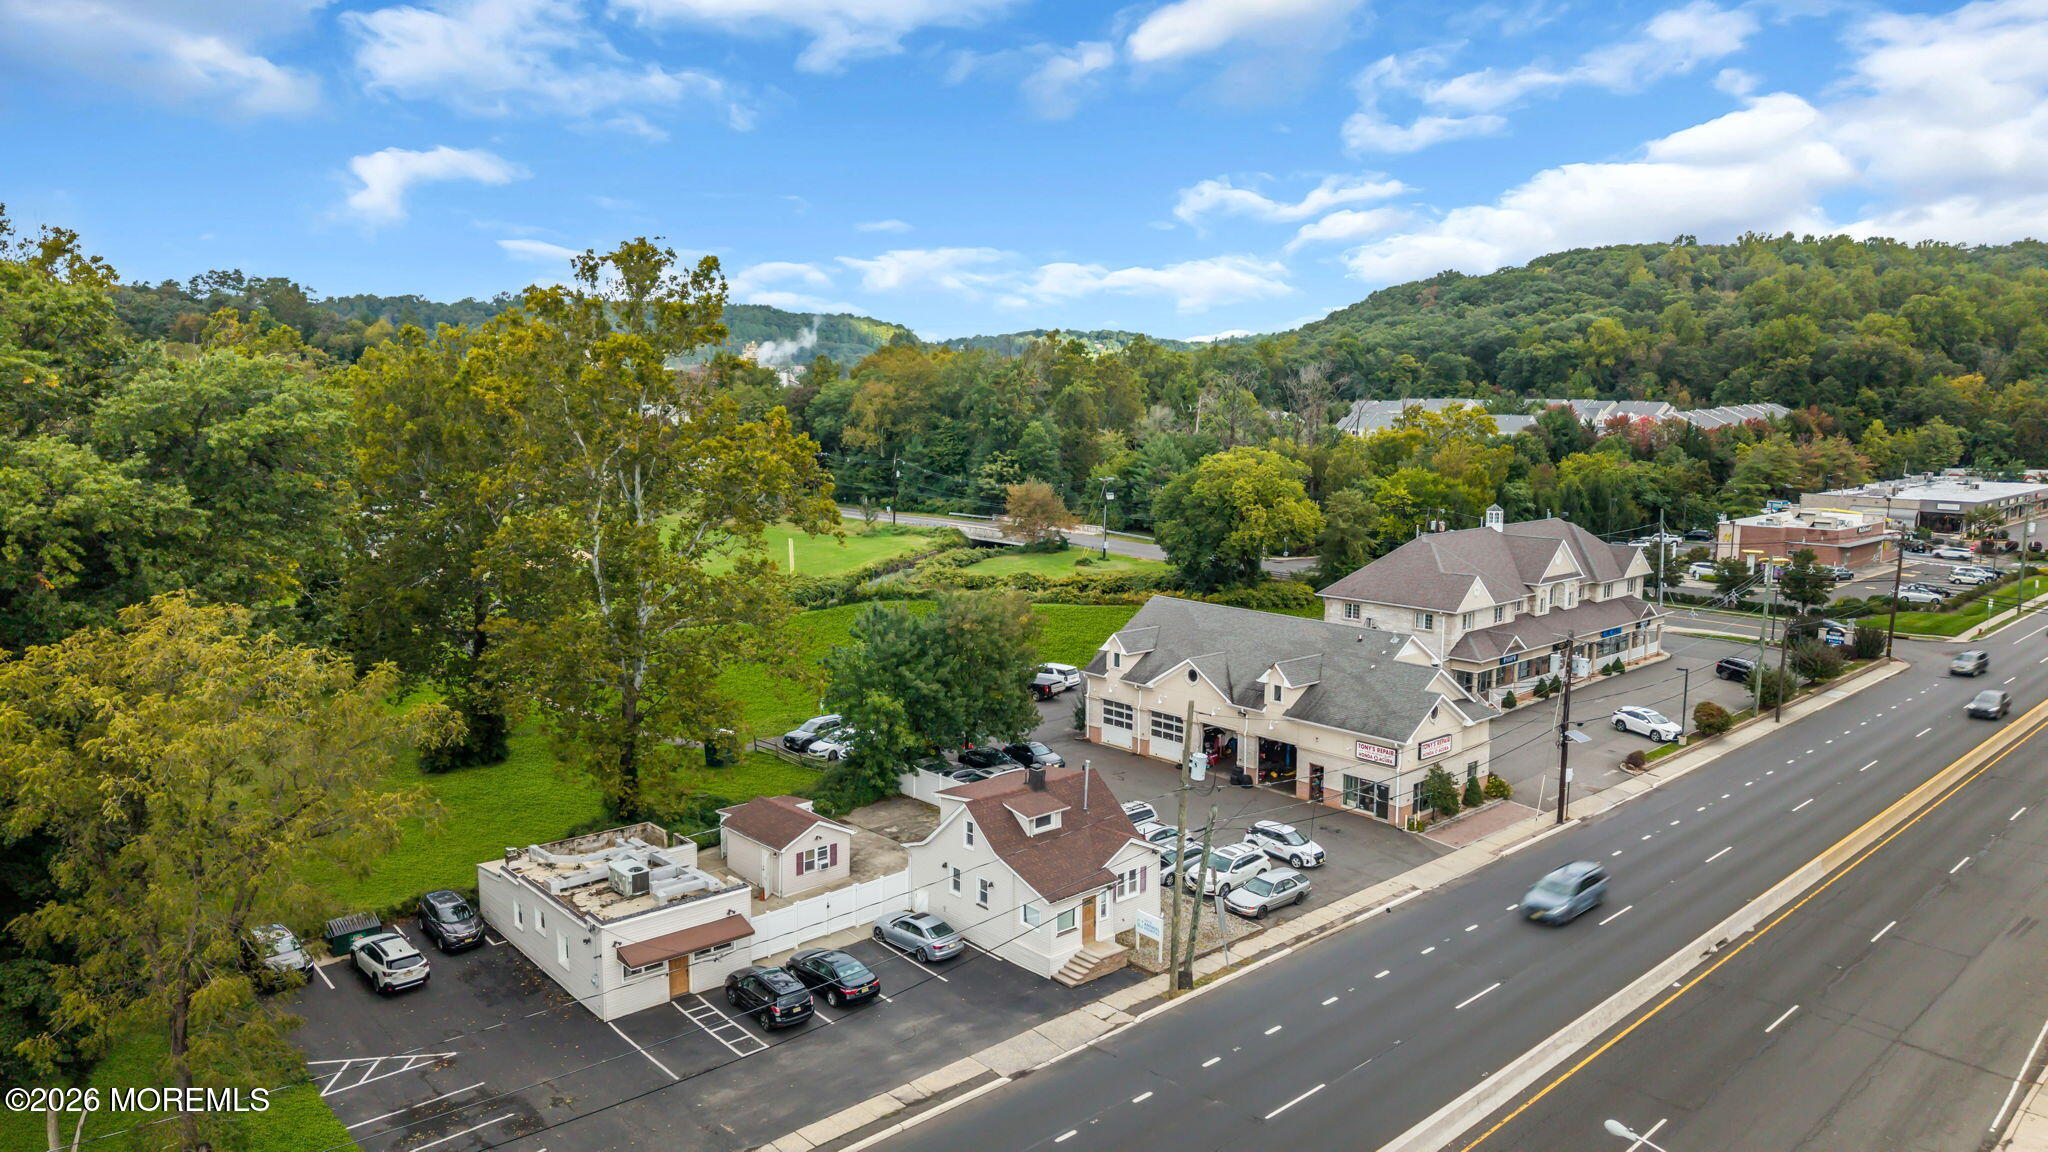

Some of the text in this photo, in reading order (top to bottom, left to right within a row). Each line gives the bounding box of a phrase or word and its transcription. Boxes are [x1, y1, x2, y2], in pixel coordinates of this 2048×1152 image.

[1436, 736, 1451, 746] REPAIR
[1358, 742, 1376, 752] TONY'S
[1376, 747, 1395, 756] REPAIR
[1378, 756, 1393, 764] ACURA
